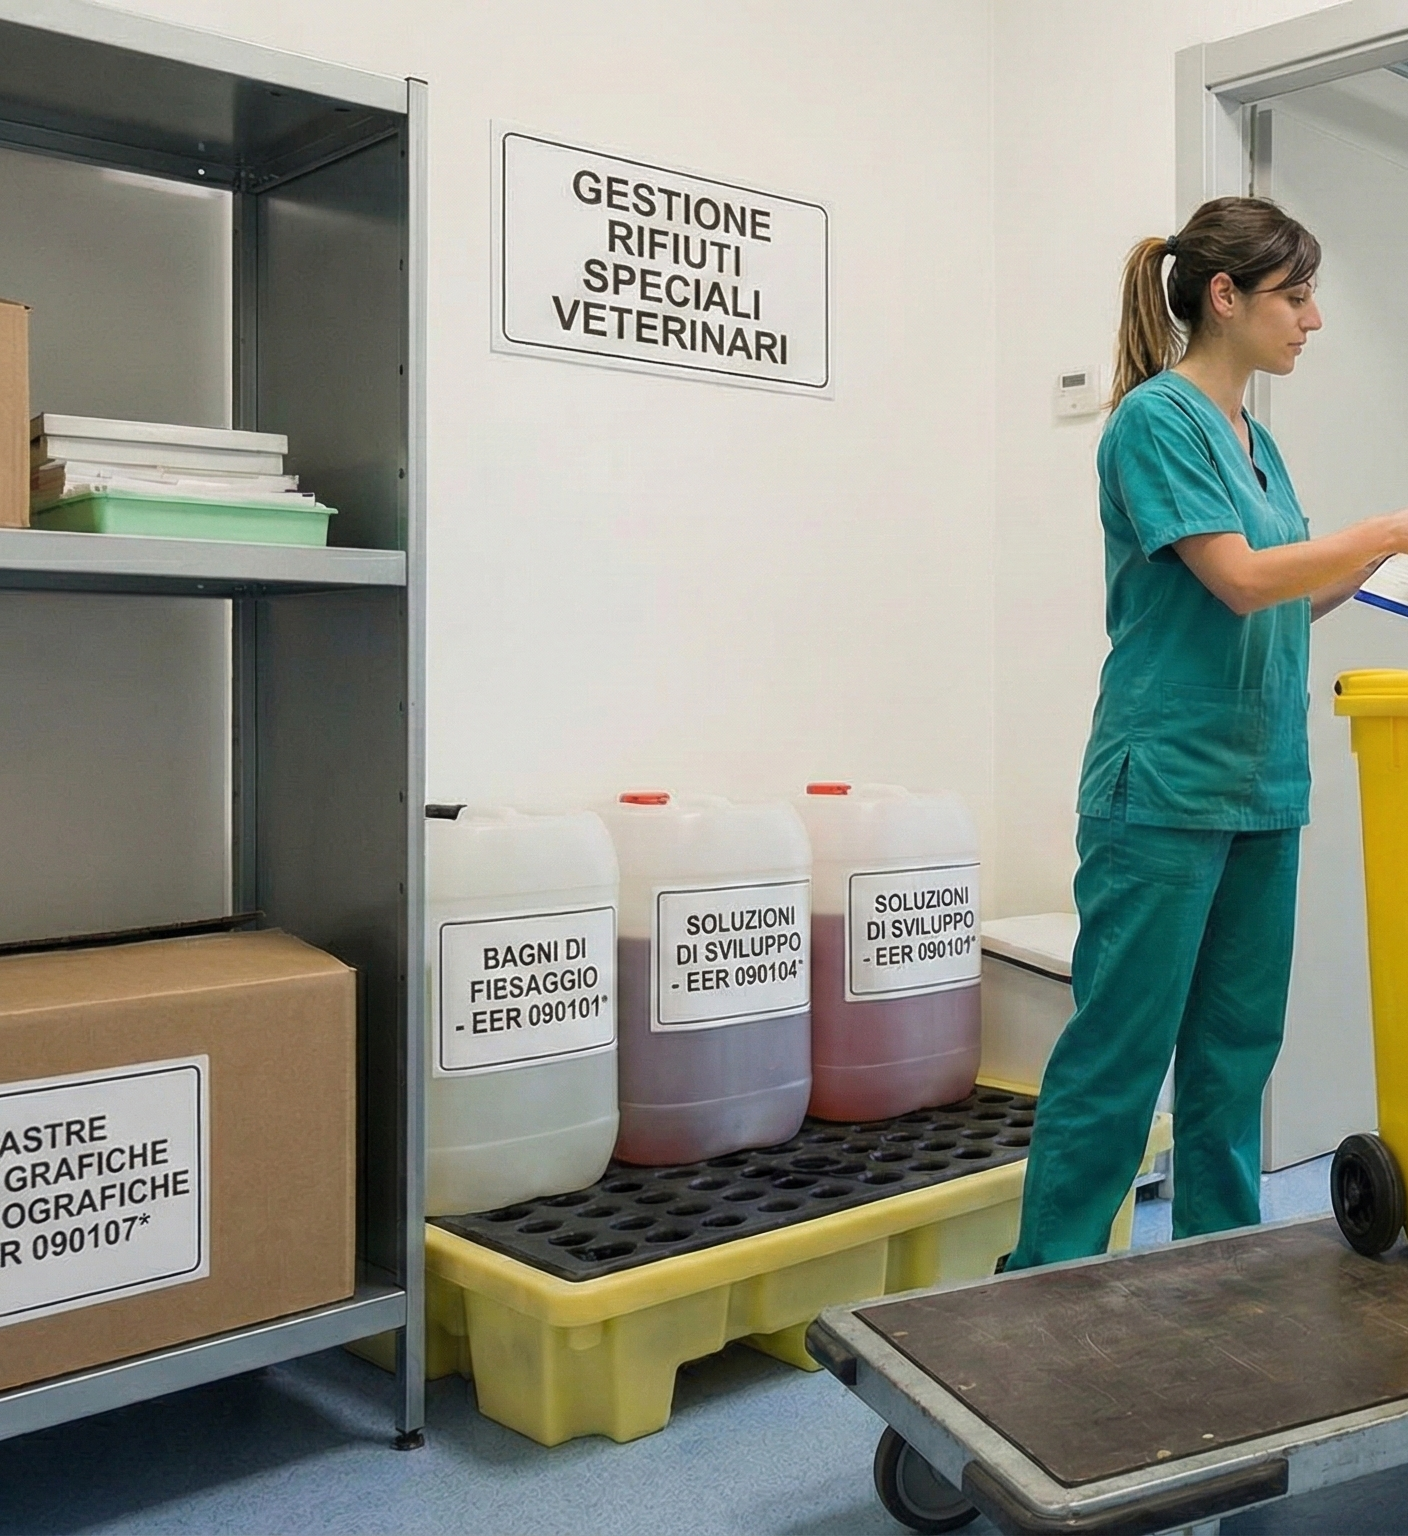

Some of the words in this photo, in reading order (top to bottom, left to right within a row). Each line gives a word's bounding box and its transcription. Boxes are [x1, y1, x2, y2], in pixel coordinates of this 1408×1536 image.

[572, 170, 772, 243] GESTIONE
[608, 219, 741, 277] RIFIUTI
[583, 258, 761, 321] SPECIALI
[551, 295, 788, 365] VETERINARI
[874, 886, 969, 914] SOLUZIONI
[686, 905, 795, 936] SOLUZIONI
[866, 920, 886, 941] DI
[891, 910, 975, 938] SVILUPPO
[483, 940, 558, 971] BAGNI
[565, 937, 587, 961] DI
[676, 944, 698, 965] DI
[704, 932, 802, 962] SVILUPPO
[875, 944, 914, 967] EER
[470, 966, 598, 1003] FIESAGGIO
[687, 968, 731, 992] EER
[472, 1007, 523, 1035] EER
[0, 1115, 108, 1158] ASTRE
[4, 1139, 169, 1193] GRAFICHE
[1, 1169, 190, 1230] OGRAFICHE
